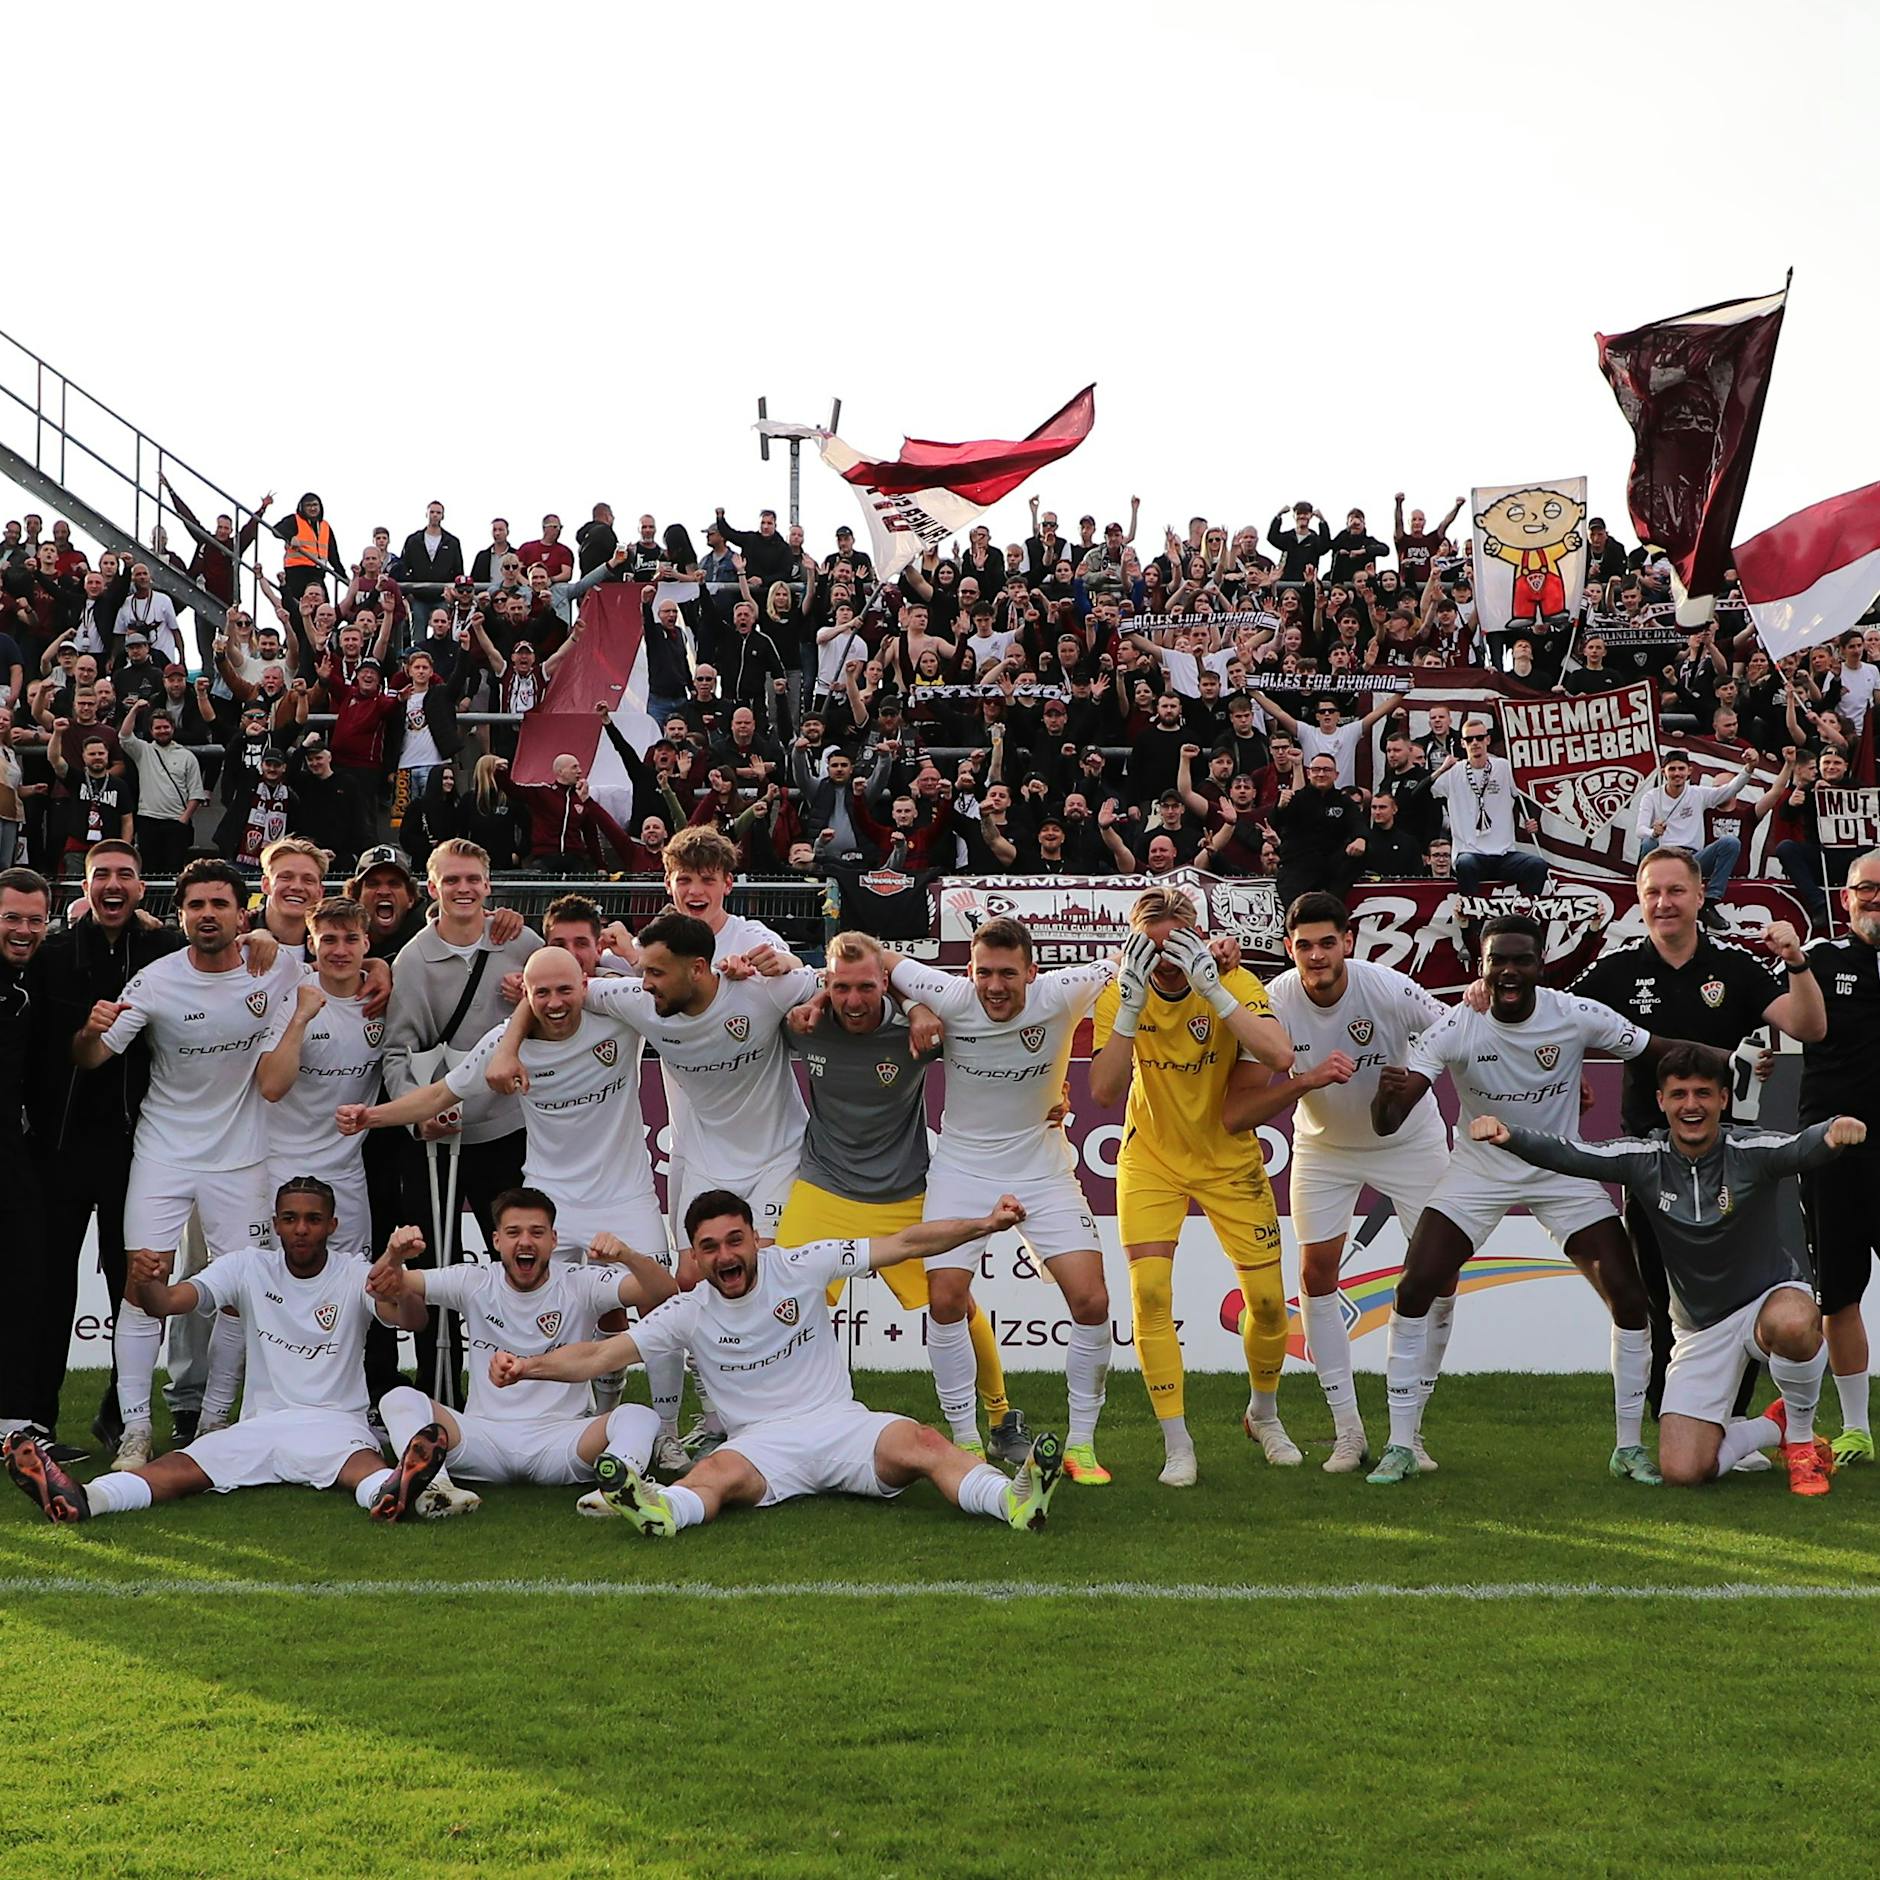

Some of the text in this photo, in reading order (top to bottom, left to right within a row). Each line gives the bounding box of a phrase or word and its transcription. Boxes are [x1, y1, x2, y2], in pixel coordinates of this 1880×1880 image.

[1208, 611, 1264, 623] DYNAMO
[1260, 672, 1301, 688] ALLES
[1337, 674, 1396, 690] DYNAMO
[916, 684, 1062, 700] DYNAMO
[1505, 689, 1648, 738] NIEMALS
[1511, 724, 1650, 768] AUFGEBEN
[1583, 772, 1635, 795] BFC
[1838, 819, 1880, 846] UL
[942, 876, 1077, 888] DYNAMO
[1071, 923, 1094, 931] CLUB
[1096, 923, 1113, 931] DER
[882, 940, 915, 953] 954
[1635, 977, 1655, 986] JAKO
[1835, 973, 1857, 982] JAKO
[1704, 982, 1722, 991] BFC
[1836, 982, 1852, 995] UG
[1640, 1004, 1652, 1014] DK
[184, 1012, 205, 1021] JAKO
[728, 1017, 746, 1027] BFC
[1139, 1024, 1156, 1033] JAKO
[1293, 1044, 1311, 1052] AKO
[807, 1053, 826, 1064] JAKO
[1140, 1051, 1217, 1074] crunchfit
[1353, 1053, 1388, 1073] fit
[1477, 1055, 1498, 1063] JAKO
[810, 1062, 824, 1077] 79
[950, 1059, 1053, 1081] crunchfit
[535, 1075, 626, 1110] crunchfit
[1469, 1081, 1569, 1104] crunchfit
[265, 1291, 283, 1304] JAKO
[776, 1299, 794, 1314] BFC
[486, 1314, 504, 1328] JAKO
[718, 1336, 740, 1344] JAKO
[720, 1326, 815, 1372] crunchfit
[654, 1395, 678, 1403] JAKO
